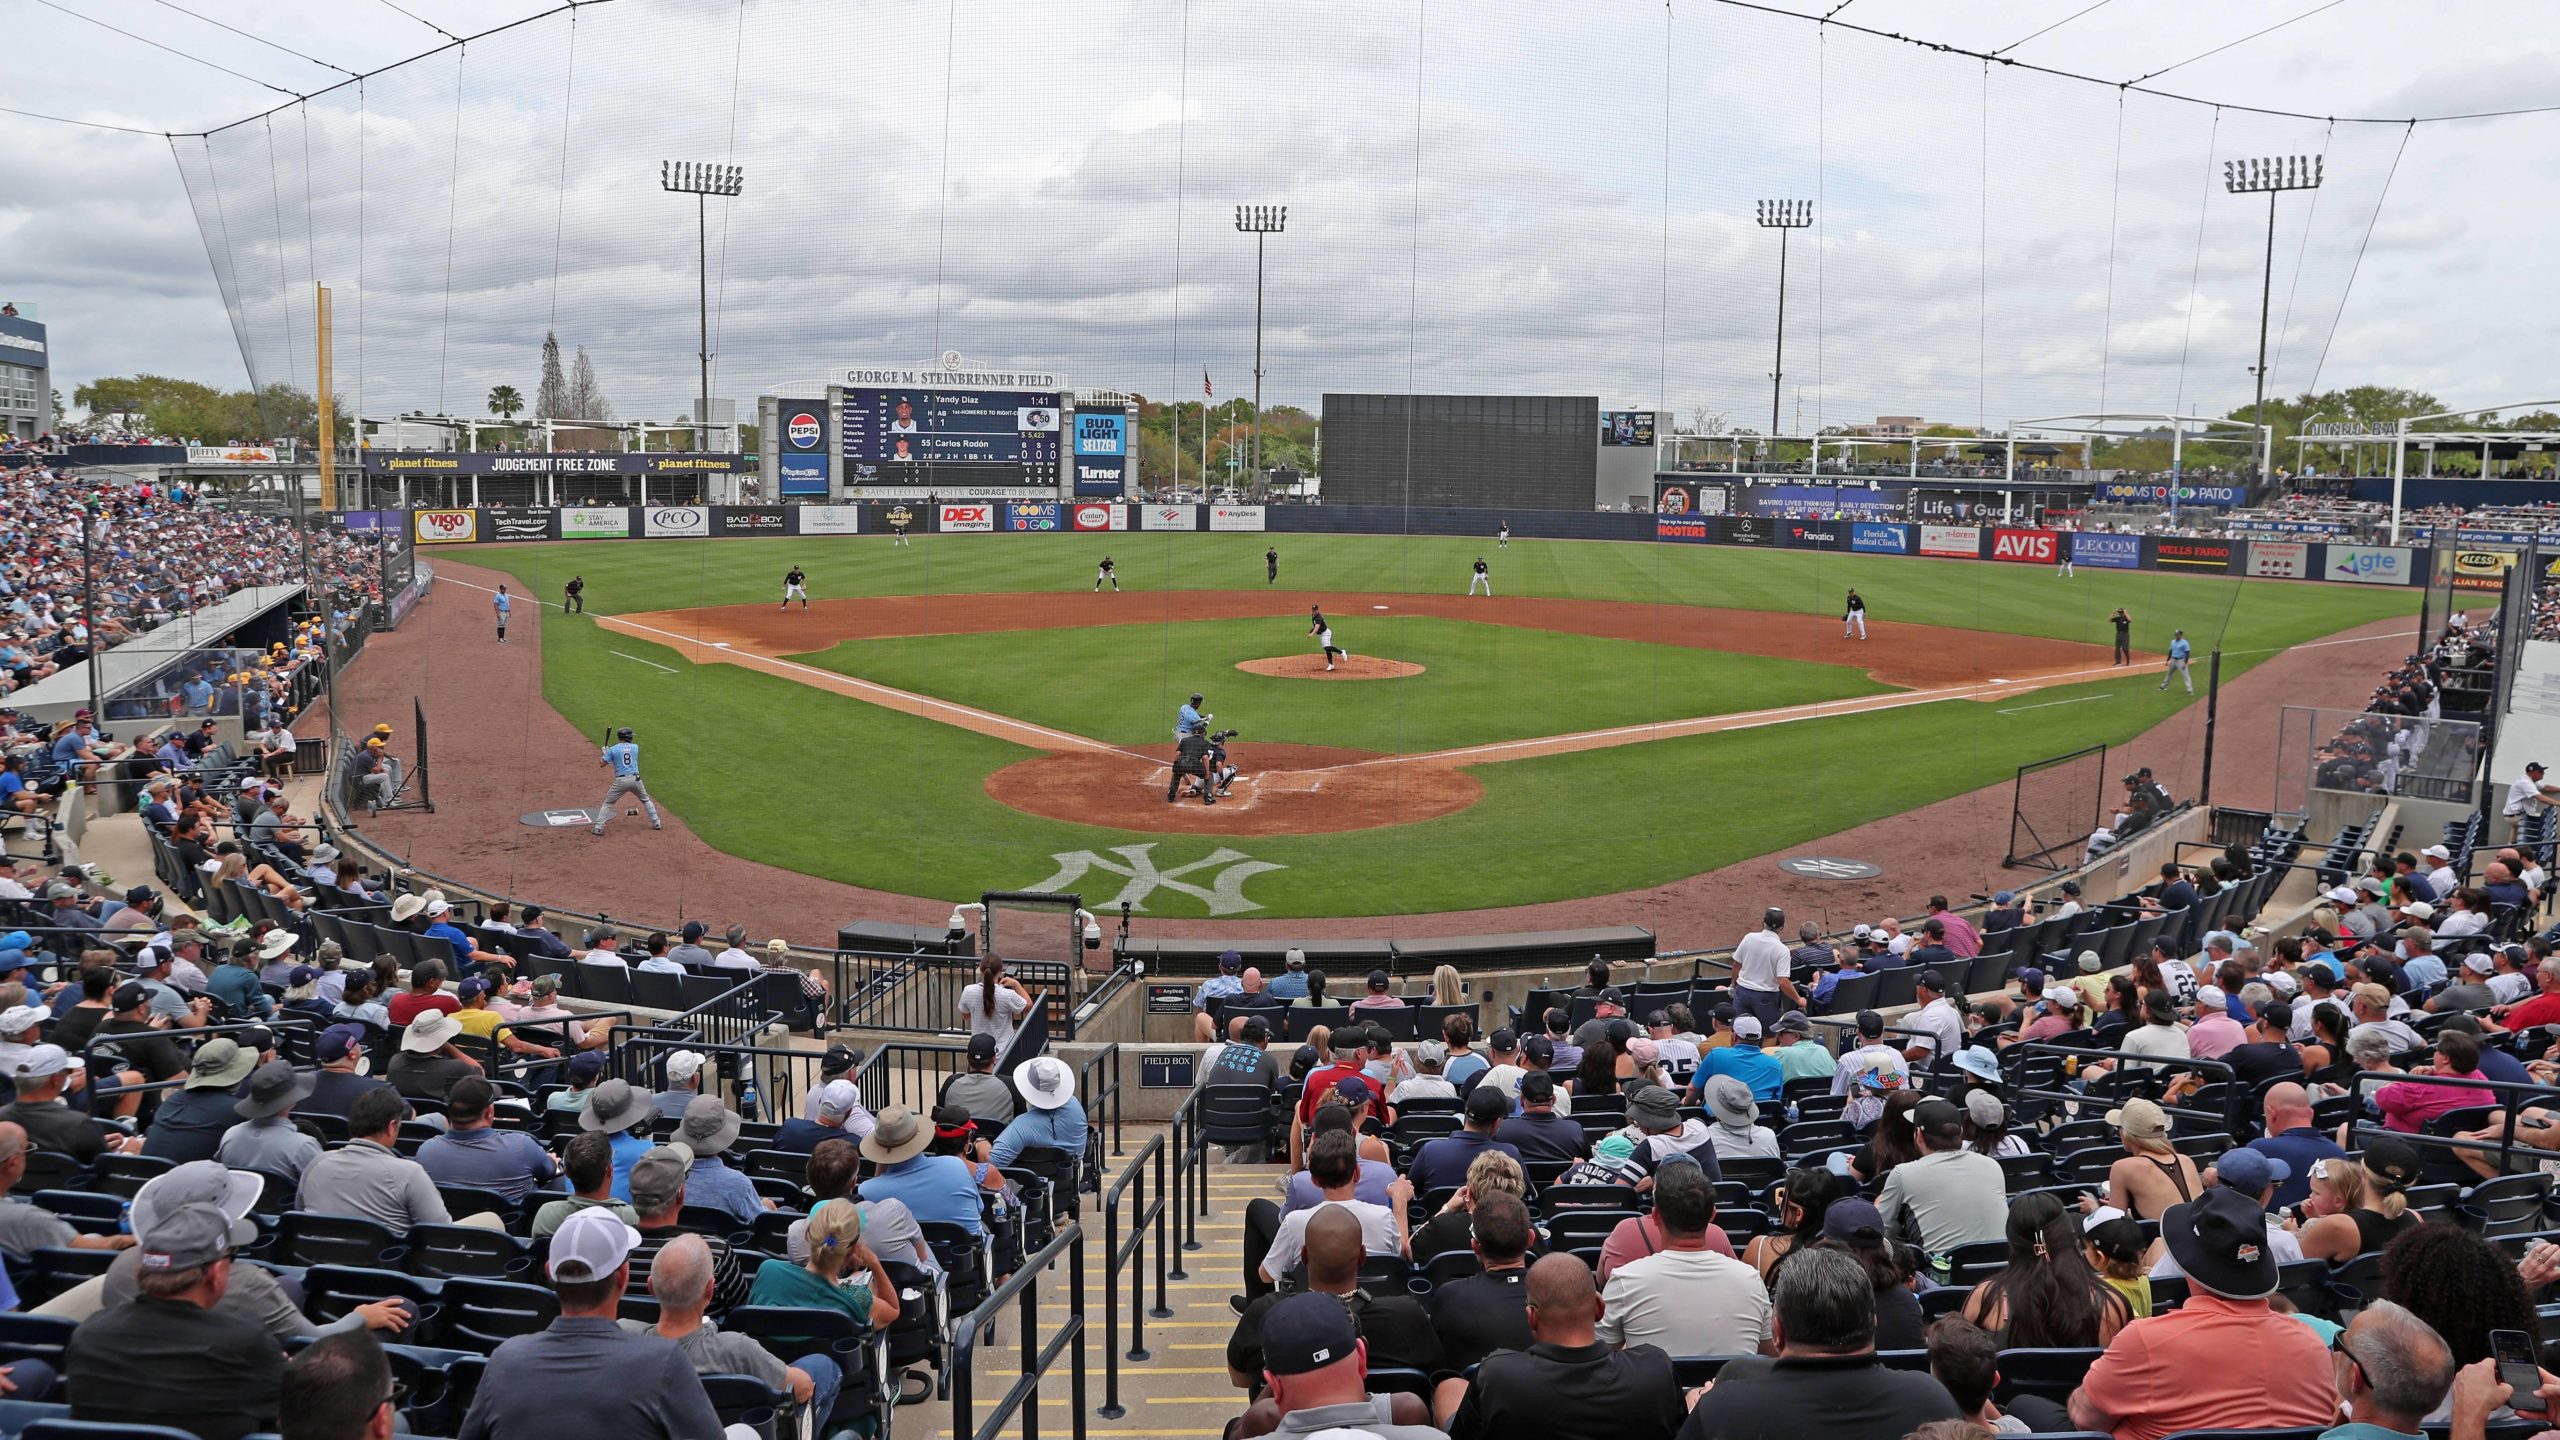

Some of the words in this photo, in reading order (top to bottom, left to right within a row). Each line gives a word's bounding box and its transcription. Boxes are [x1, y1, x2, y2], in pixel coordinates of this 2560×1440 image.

[847, 371, 898, 384] GEORGE
[902, 371, 916, 384] M.
[921, 372, 1014, 386] STEINBRENNER
[1018, 374, 1053, 387] FIELD
[935, 395, 960, 405] Yandy
[1031, 397, 1048, 406] 1:41
[1086, 418, 1114, 428] BUD
[1080, 429, 1120, 439] LIGHT
[1083, 439, 1116, 452] SELTZER
[1022, 450, 1028, 459] 0
[1036, 450, 1042, 459] 0
[1050, 450, 1056, 459] 0
[390, 458, 422, 470] planet
[424, 458, 458, 468] fitness
[492, 458, 553, 471] JUDGEMENT
[557, 459, 584, 471] FREE
[587, 459, 617, 471] ZONE
[659, 459, 693, 470] planet
[695, 459, 730, 469] fitness
[1078, 466, 1120, 479] Turner
[894, 488, 911, 496] LEO
[2107, 486, 2150, 497] ROOMS
[2151, 486, 2167, 498] TO
[2199, 488, 2232, 500] PATIO
[1012, 505, 1055, 516] ROOMS
[1923, 501, 1952, 514] Life
[662, 512, 691, 524] PCC
[943, 508, 987, 521] DEX
[1080, 513, 1104, 521] Century
[1012, 519, 1027, 530] TO
[1029, 519, 1050, 530] GO
[1658, 526, 1706, 537] HOOTERS
[1804, 532, 1834, 541] Fanatics
[1864, 530, 1888, 538] Florida
[1946, 531, 1976, 539] n-lorem
[1878, 539, 1898, 547] Clinic
[1995, 535, 2050, 558] AVIS
[2159, 545, 2192, 555] WELLS
[2194, 547, 2229, 557] FARGO
[2360, 553, 2396, 572] gte
[2461, 555, 2496, 564] ALESSI
[624, 753, 631, 765] 8
[1578, 1165, 1612, 1180] JUDGE
